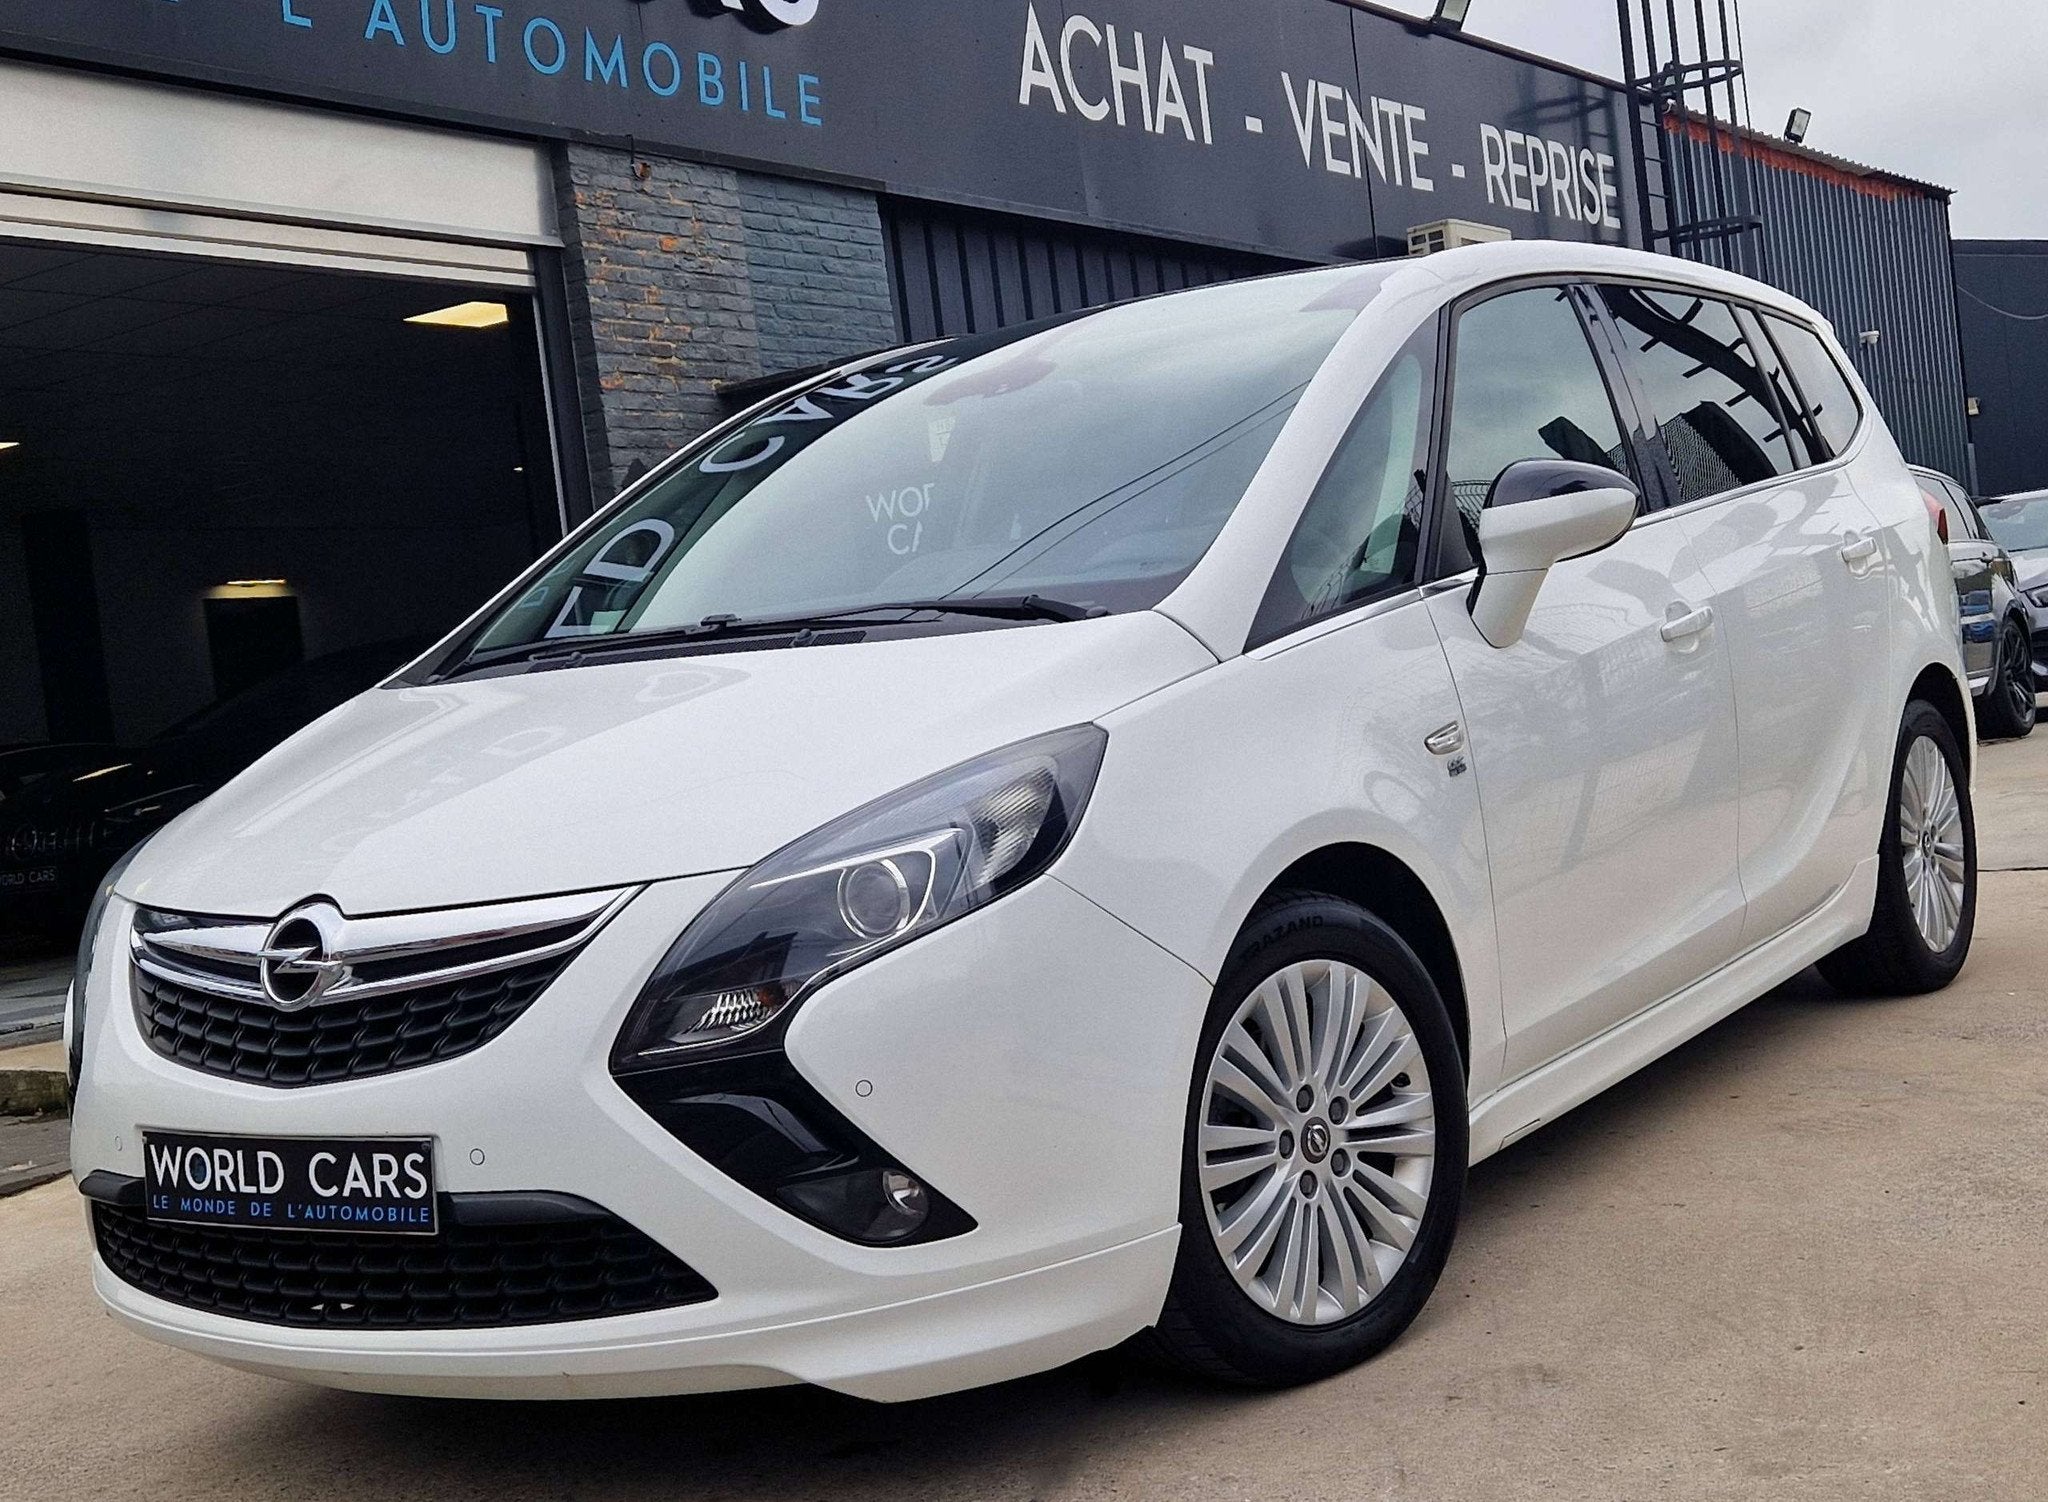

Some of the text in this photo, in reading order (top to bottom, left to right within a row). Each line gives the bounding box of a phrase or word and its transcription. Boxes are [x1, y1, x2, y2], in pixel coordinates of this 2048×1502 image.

[1018, 1, 1214, 145] ACHAT
[1281, 71, 1435, 192] VENTE
[1480, 122, 1622, 229] REPRISE
[0, 874, 24, 886] ORLD
[150, 1144, 428, 1198] WORLD CARS
[153, 1194, 429, 1224] LE MONDE DE L'AUTOMOBILE
